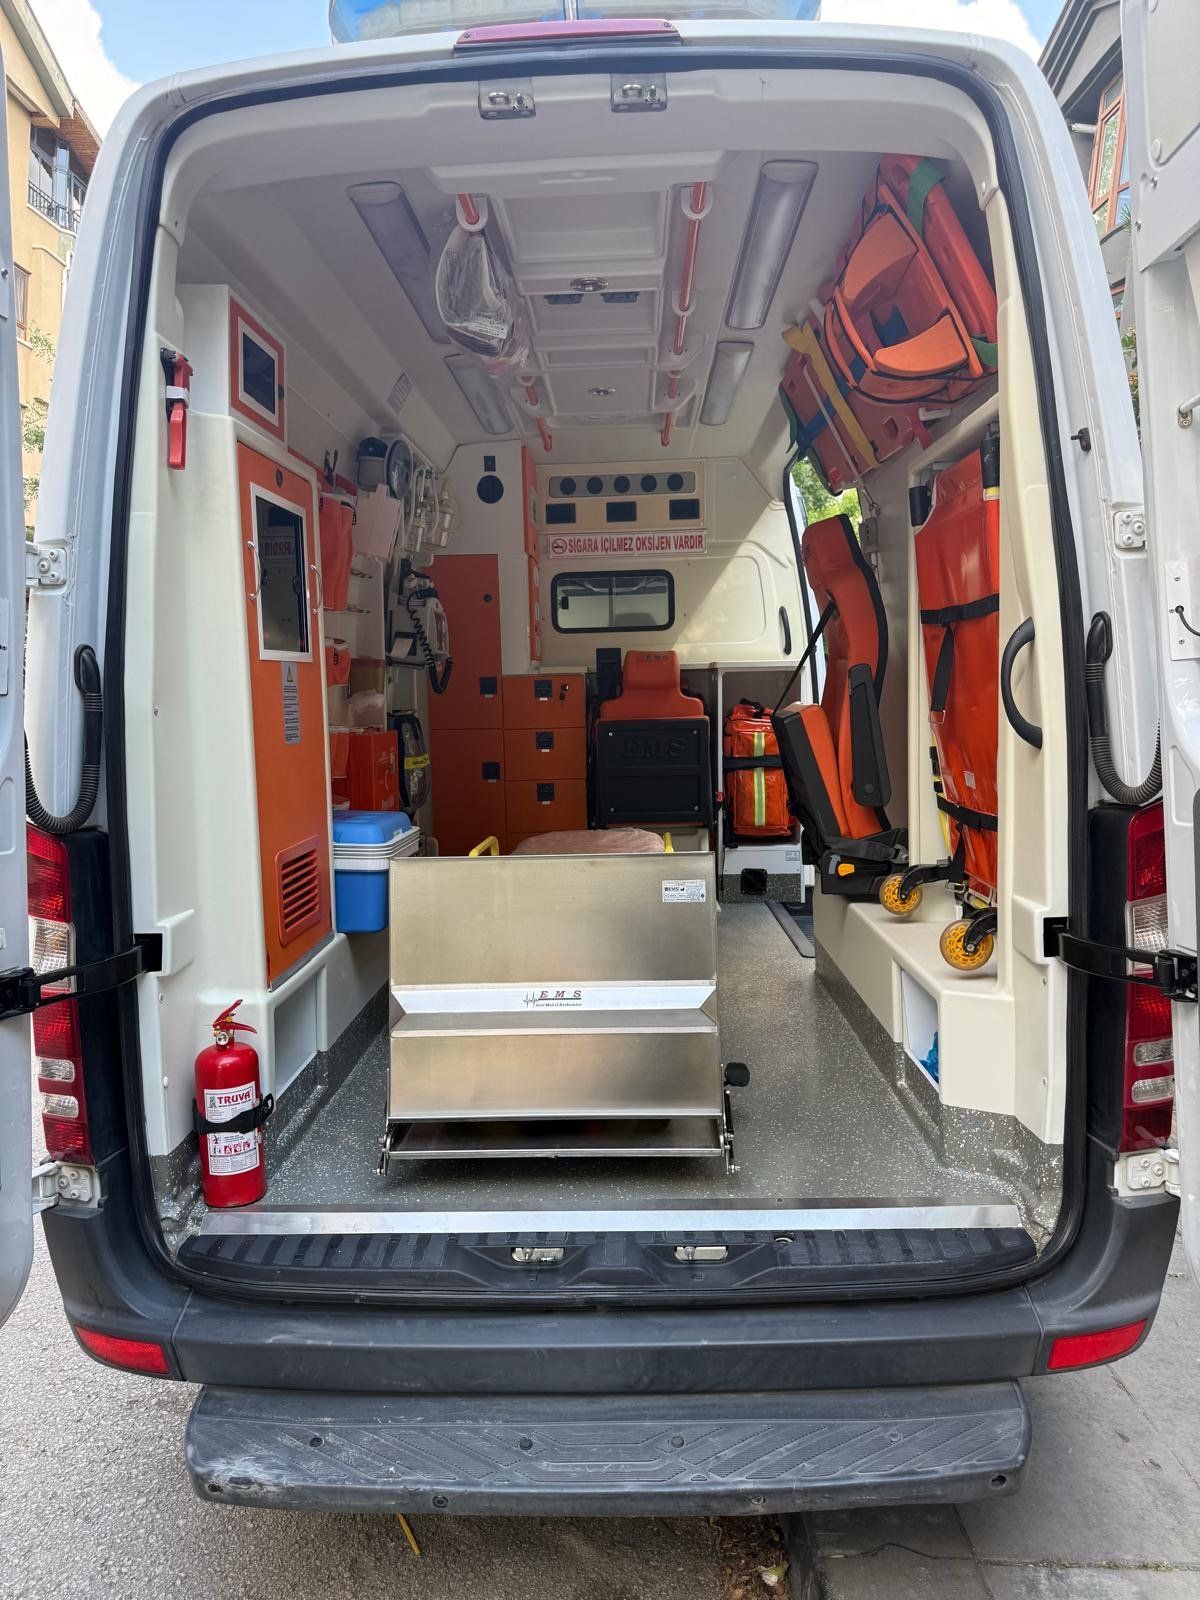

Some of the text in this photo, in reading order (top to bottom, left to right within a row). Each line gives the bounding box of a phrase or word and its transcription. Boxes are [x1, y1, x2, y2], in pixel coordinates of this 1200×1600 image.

[600, 535, 634, 554] İÇİLMEZ
[635, 534, 671, 551] OKSİJEN
[673, 534, 704, 550] VARDIR
[217, 1090, 251, 1105] TRUVA
